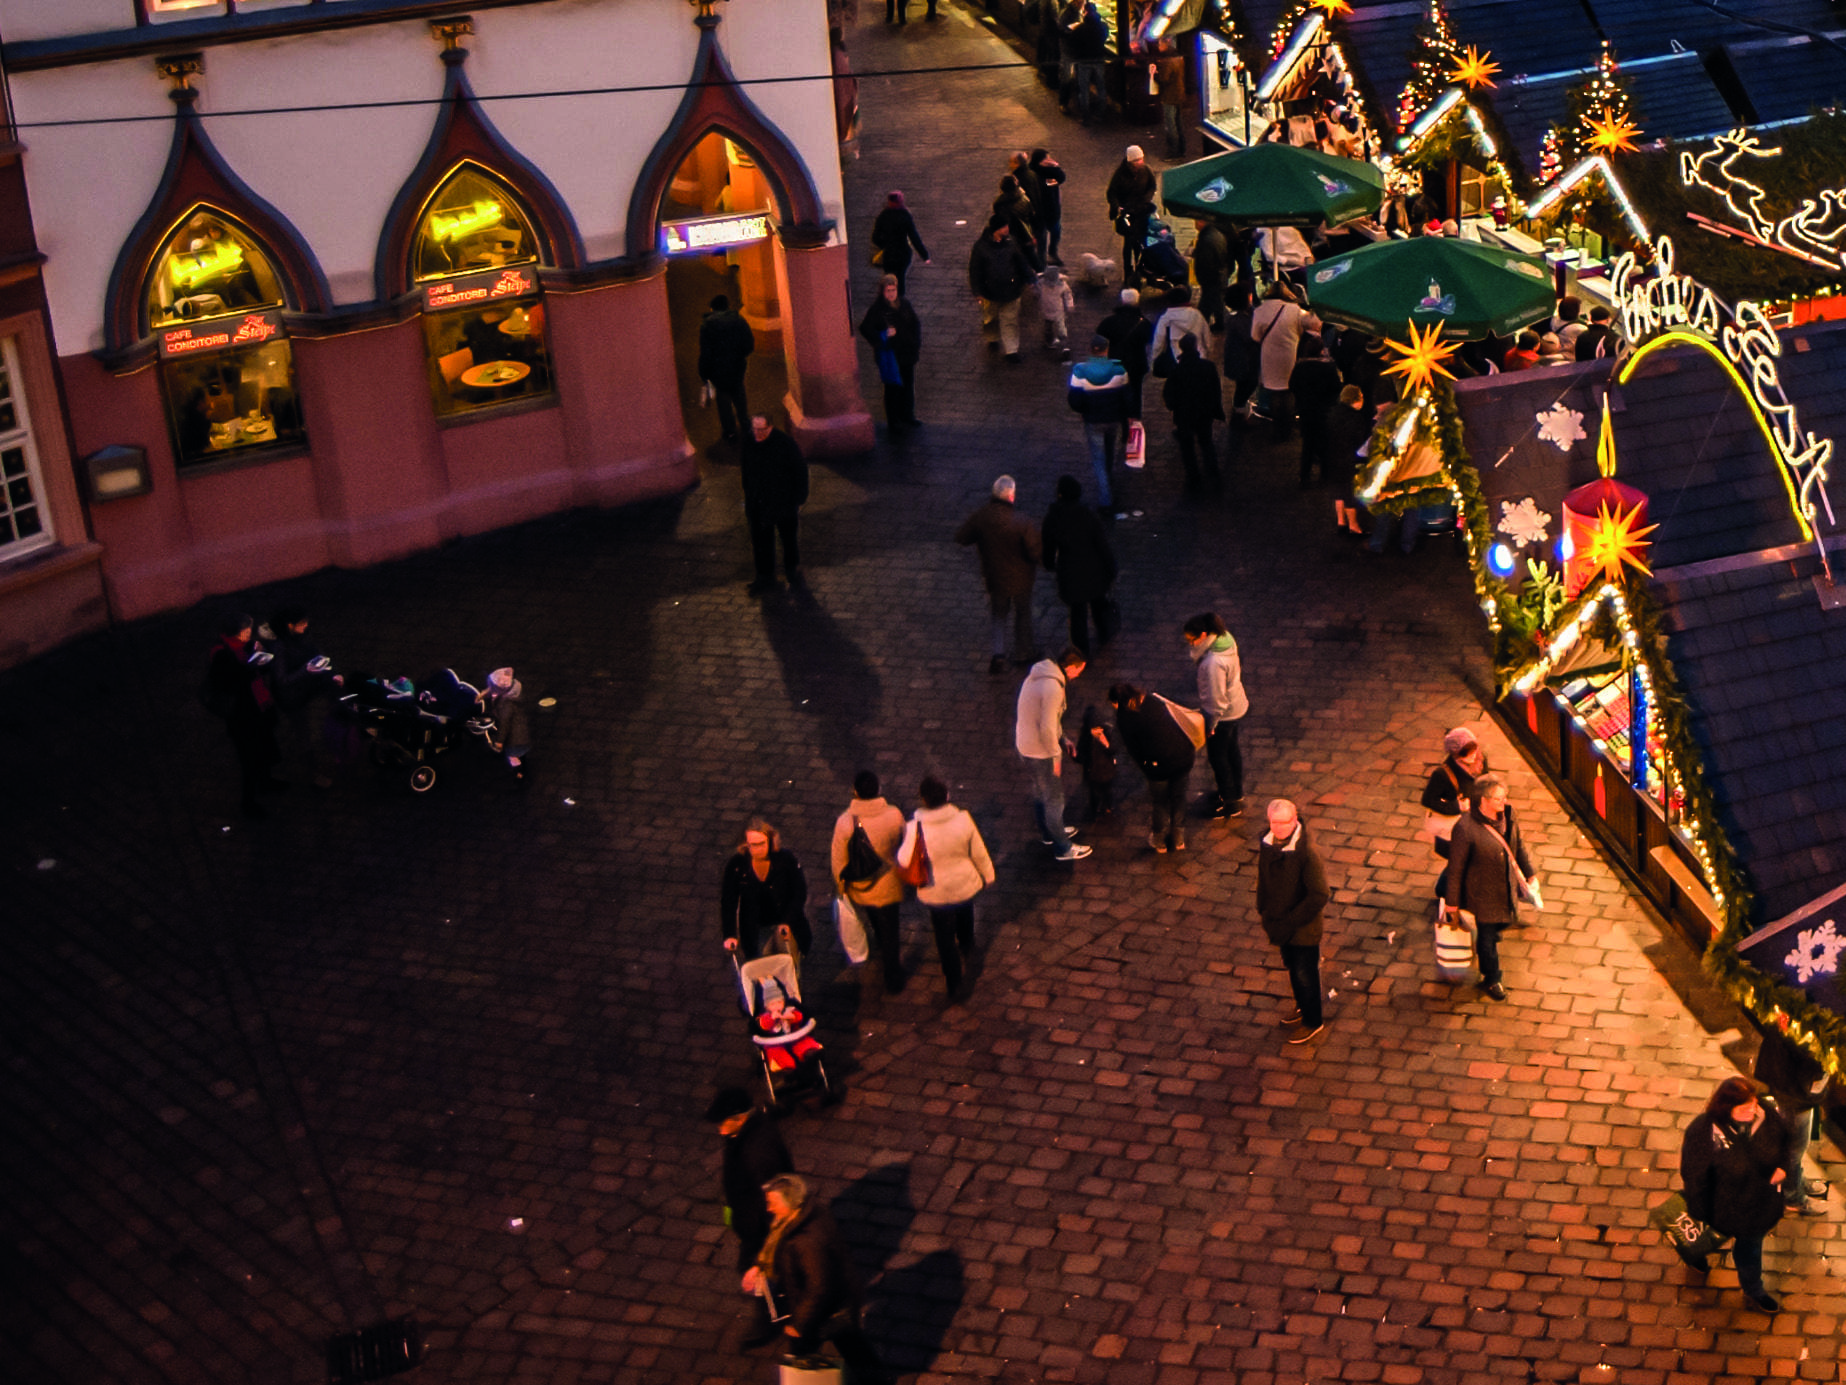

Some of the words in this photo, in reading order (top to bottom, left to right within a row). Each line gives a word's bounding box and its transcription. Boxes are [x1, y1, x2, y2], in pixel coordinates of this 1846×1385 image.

[427, 282, 455, 296] CAFE
[428, 287, 488, 307] CONDITOREI
[164, 328, 193, 342] CAFE
[166, 332, 230, 353] CONDITOREI
